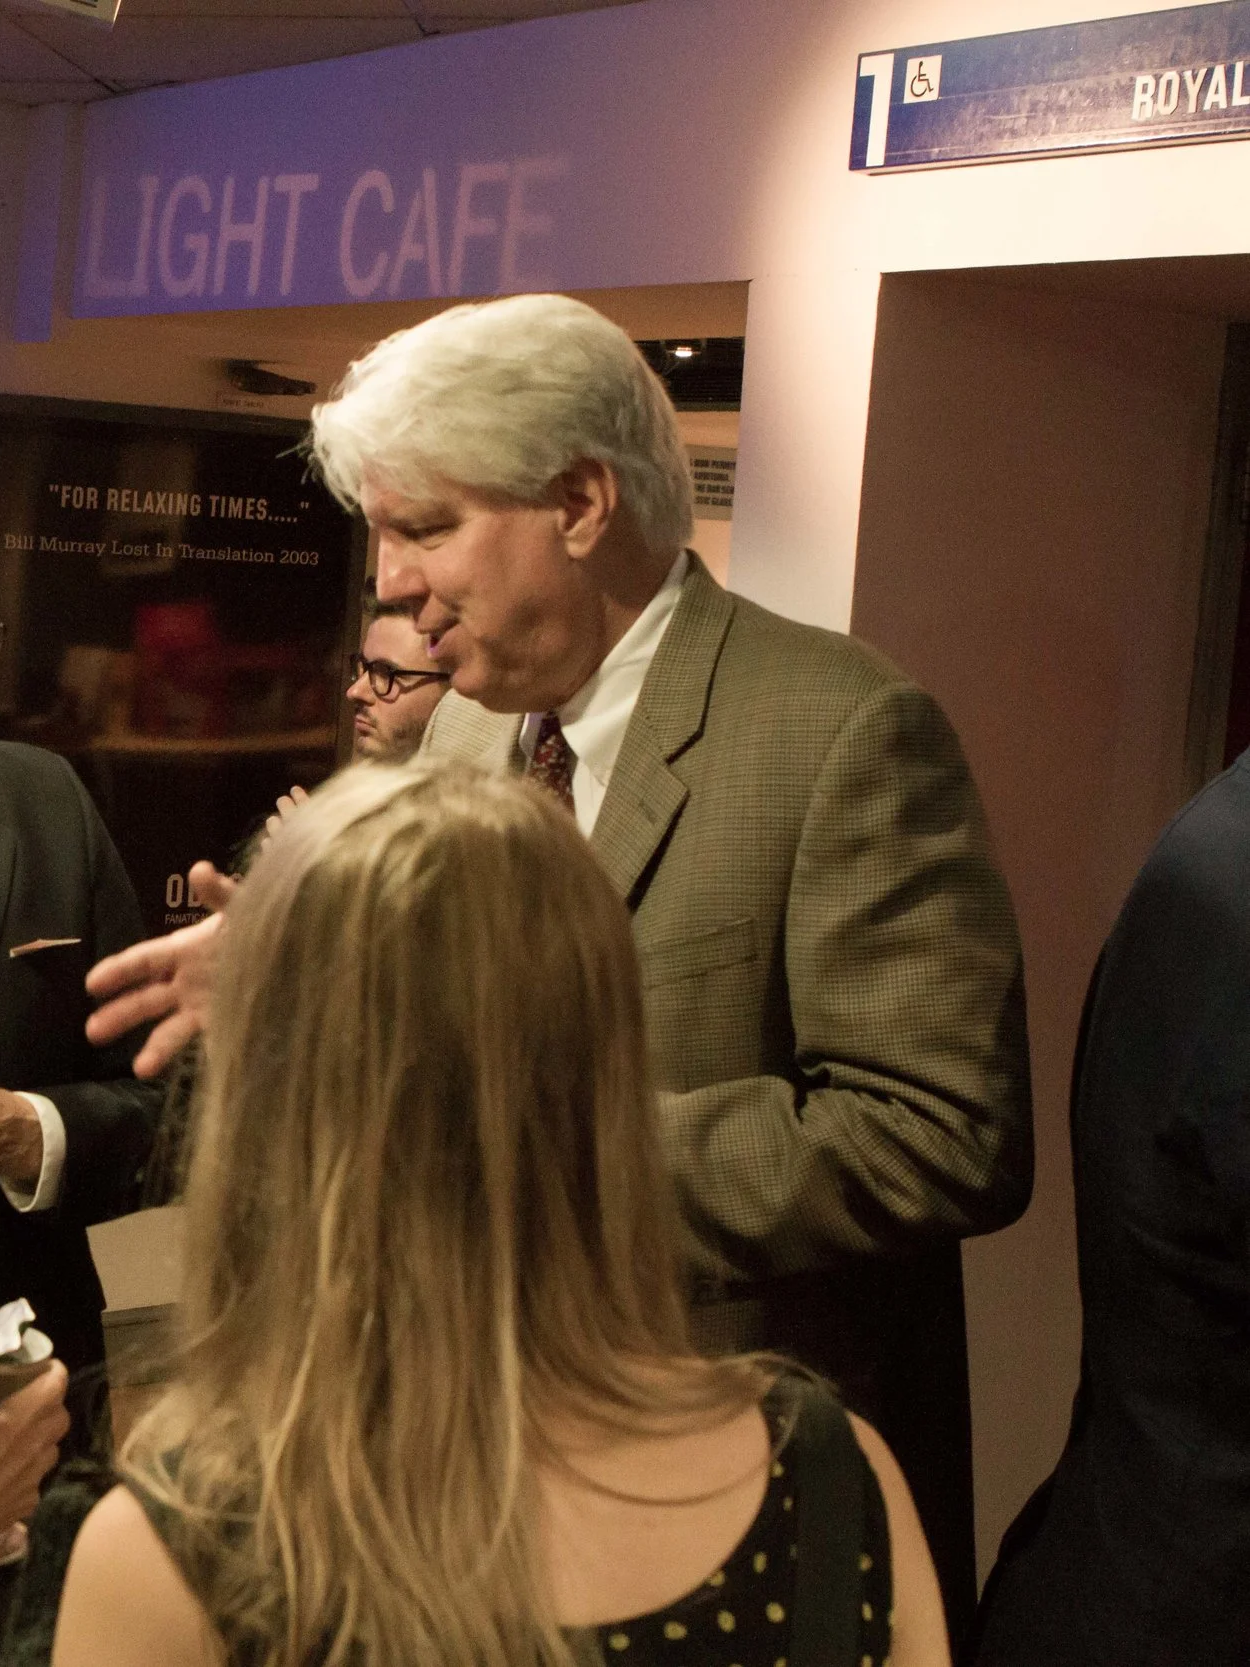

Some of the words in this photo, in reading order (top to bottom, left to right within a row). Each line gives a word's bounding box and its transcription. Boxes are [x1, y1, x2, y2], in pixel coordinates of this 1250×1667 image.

[859, 53, 894, 167] 1
[1132, 61, 1250, 120] ROYAL
[85, 172, 320, 297] LIGHT
[338, 157, 570, 296] CAFE
[49, 484, 99, 510] "FOR
[106, 489, 201, 517] RELAXING
[4, 534, 35, 551] Bill
[40, 536, 106, 557] Murray
[111, 540, 151, 557] Lost
[156, 543, 173, 558] In
[179, 544, 275, 564] Translation
[279, 550, 320, 566] 2003
